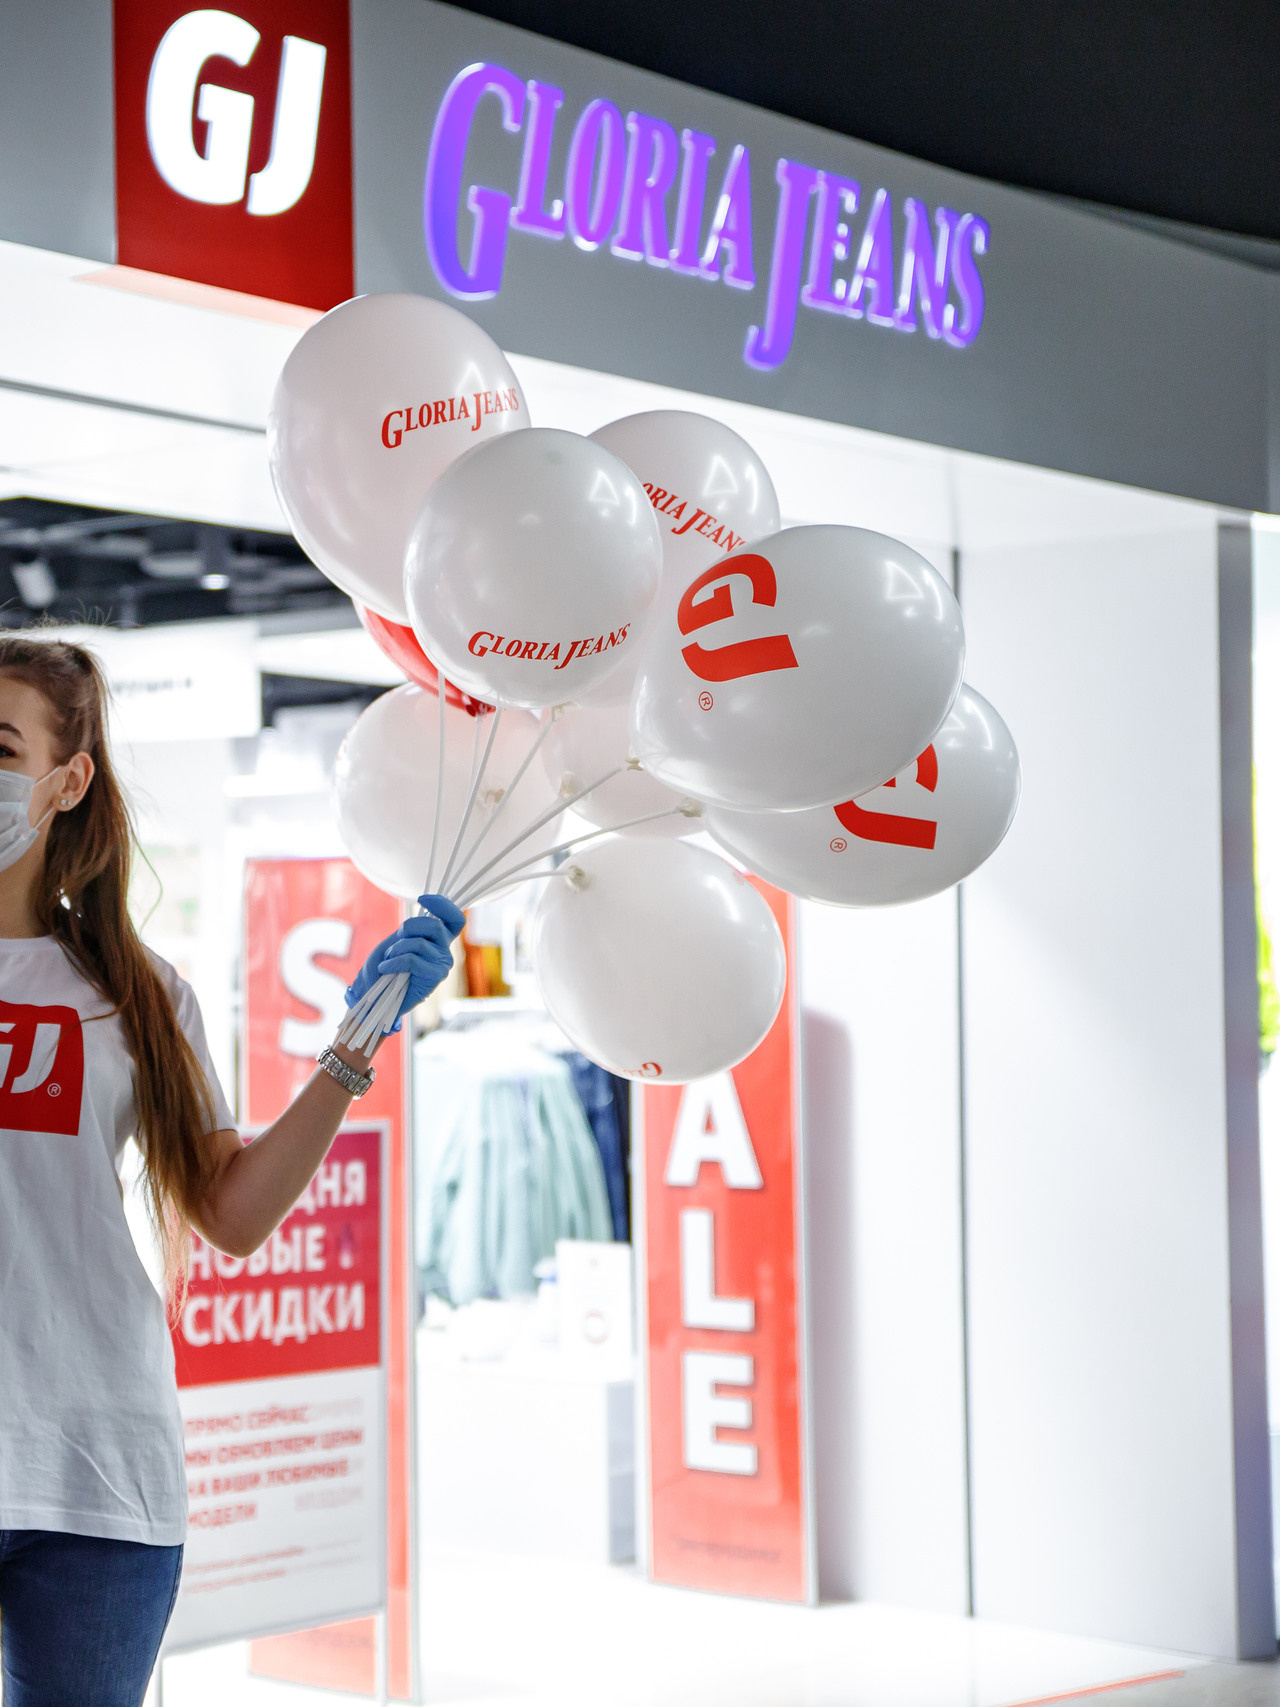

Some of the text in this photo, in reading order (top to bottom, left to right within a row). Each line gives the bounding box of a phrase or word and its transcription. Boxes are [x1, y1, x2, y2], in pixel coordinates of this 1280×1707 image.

[146, 9, 327, 217] GJ
[425, 62, 991, 371] GLORIA JEANS
[381, 388, 519, 449] GLORIA JEANS
[642, 482, 746, 552] ORIA JEAN
[468, 623, 631, 669] GLORIA JEANS
[677, 554, 799, 683] GJ
[182, 1281, 366, 1348] СКИДКИ
[665, 1071, 764, 1477] ALE
